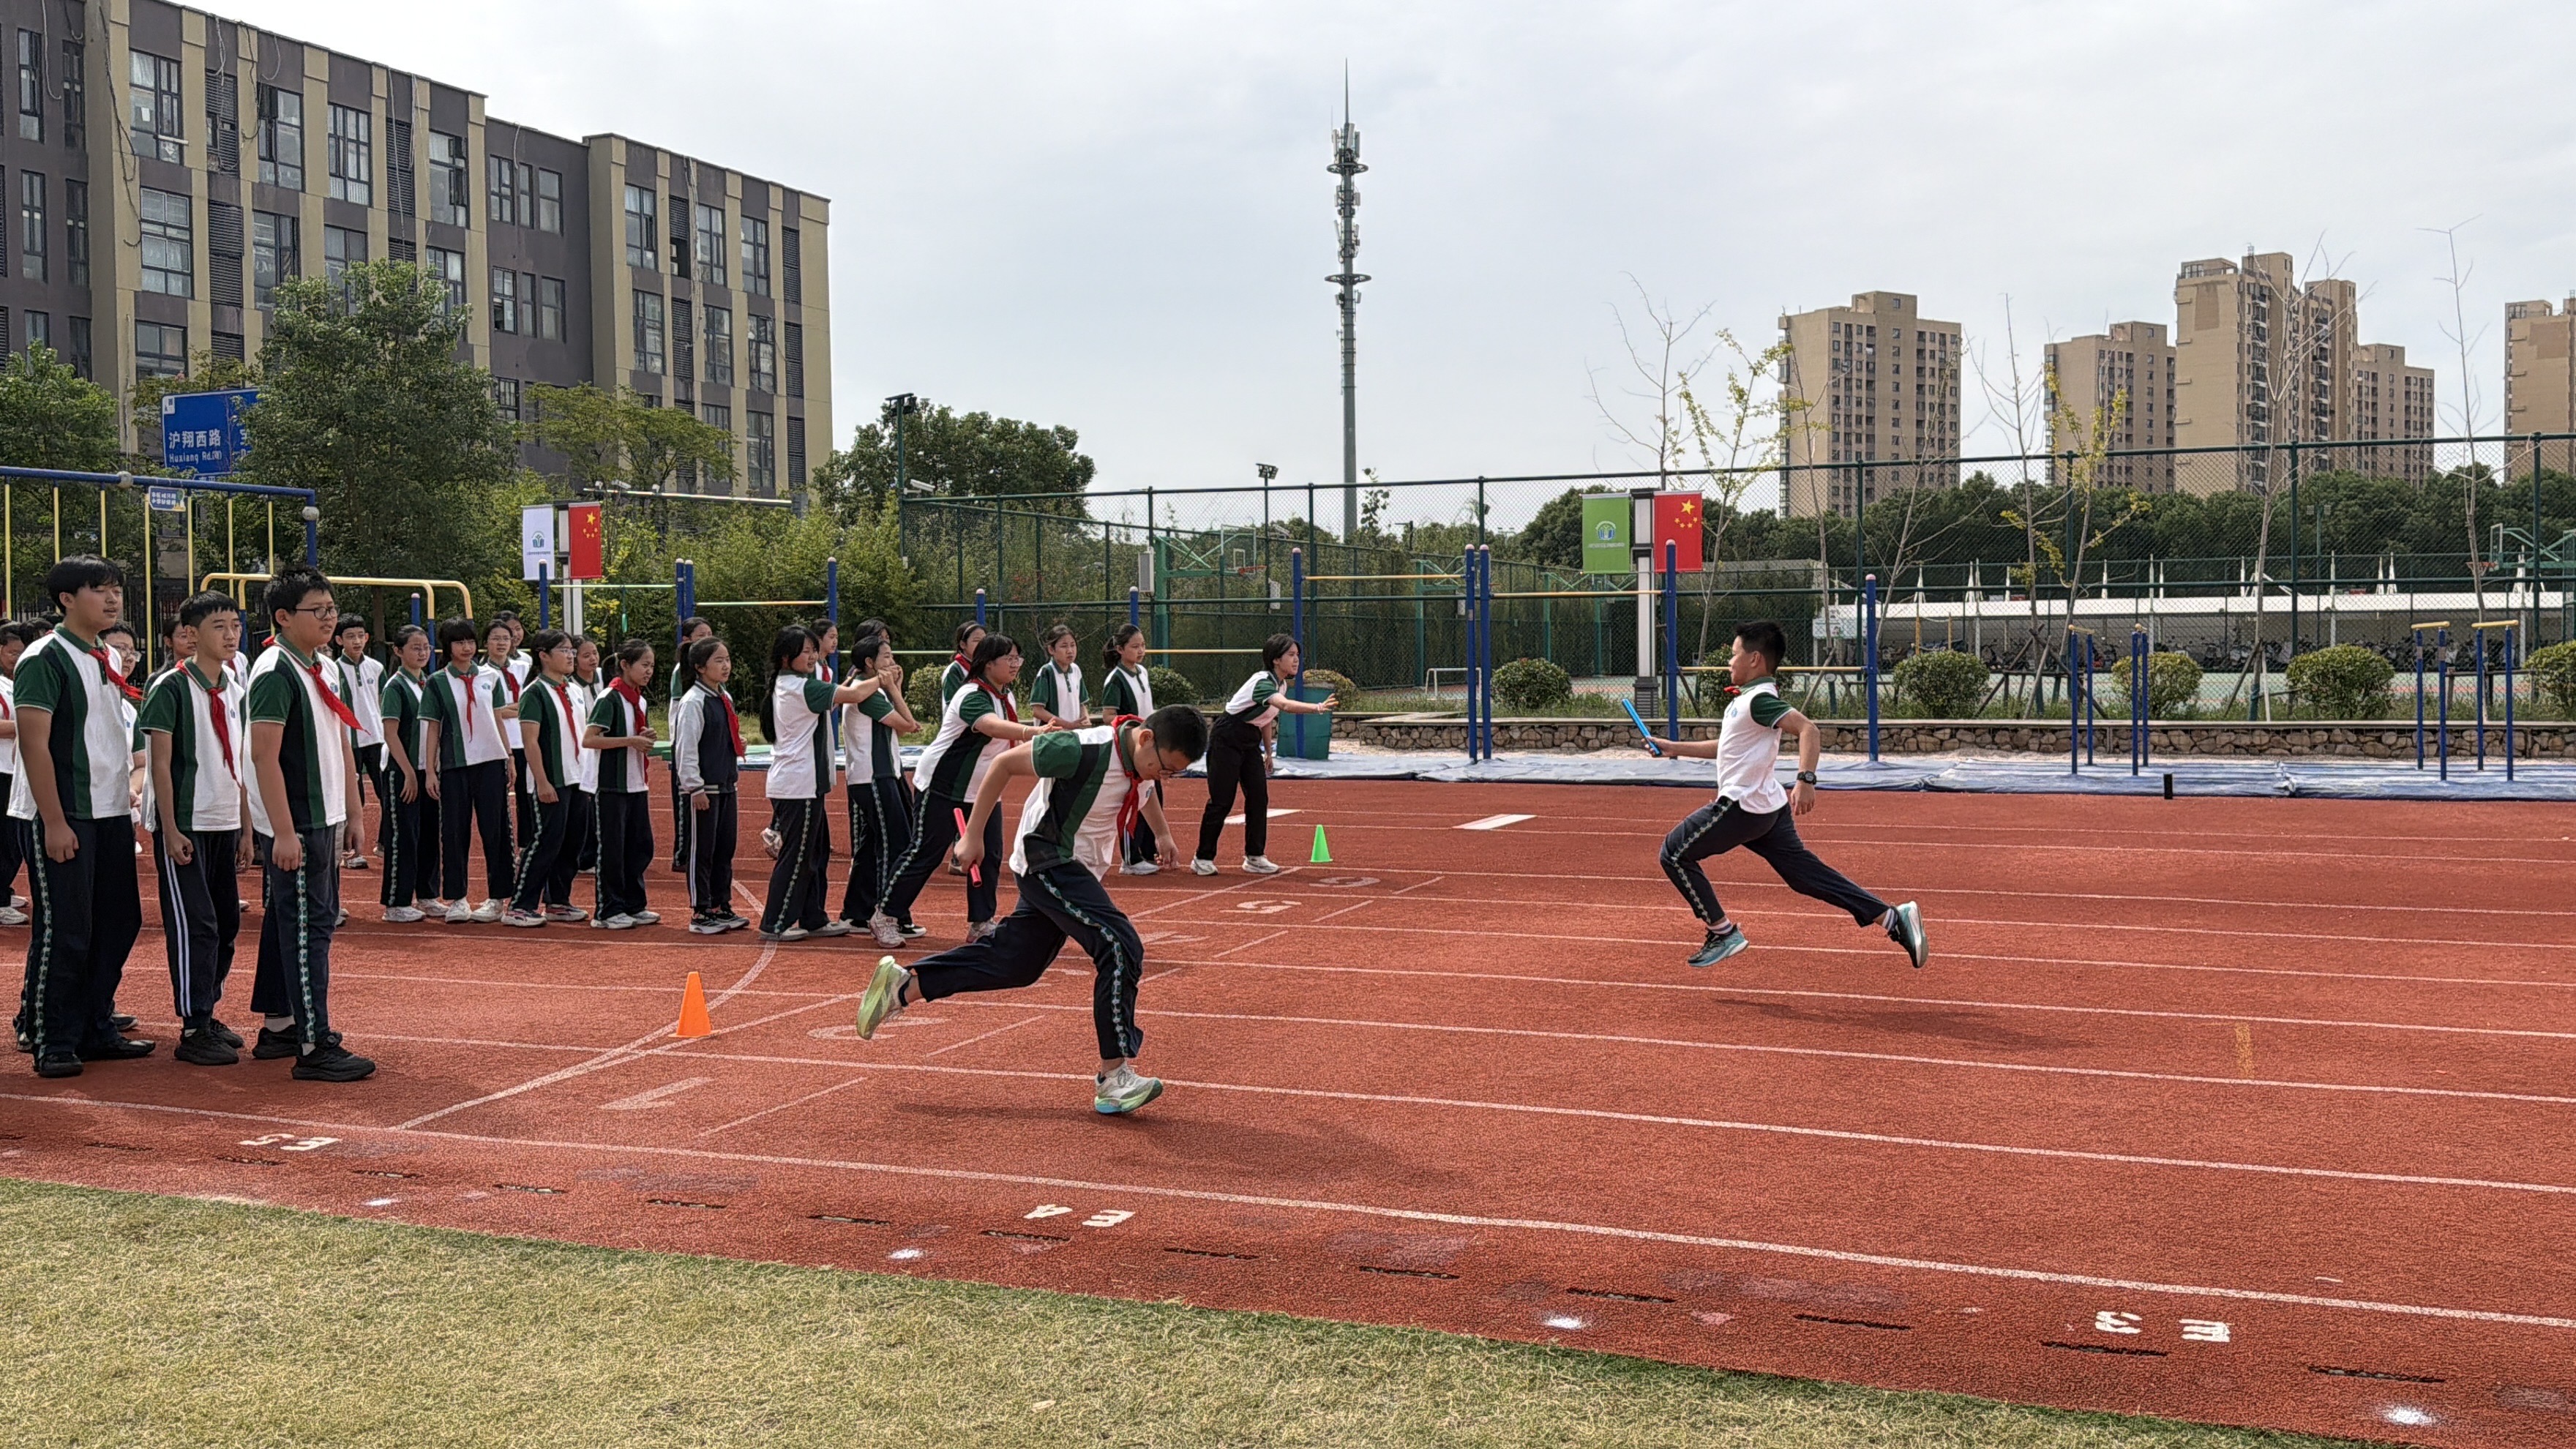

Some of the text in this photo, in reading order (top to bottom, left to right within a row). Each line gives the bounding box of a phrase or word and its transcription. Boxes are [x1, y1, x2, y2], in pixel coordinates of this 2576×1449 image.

[168, 429, 221, 449] 沪翔西路
[168, 452, 199, 465] Huxiang
